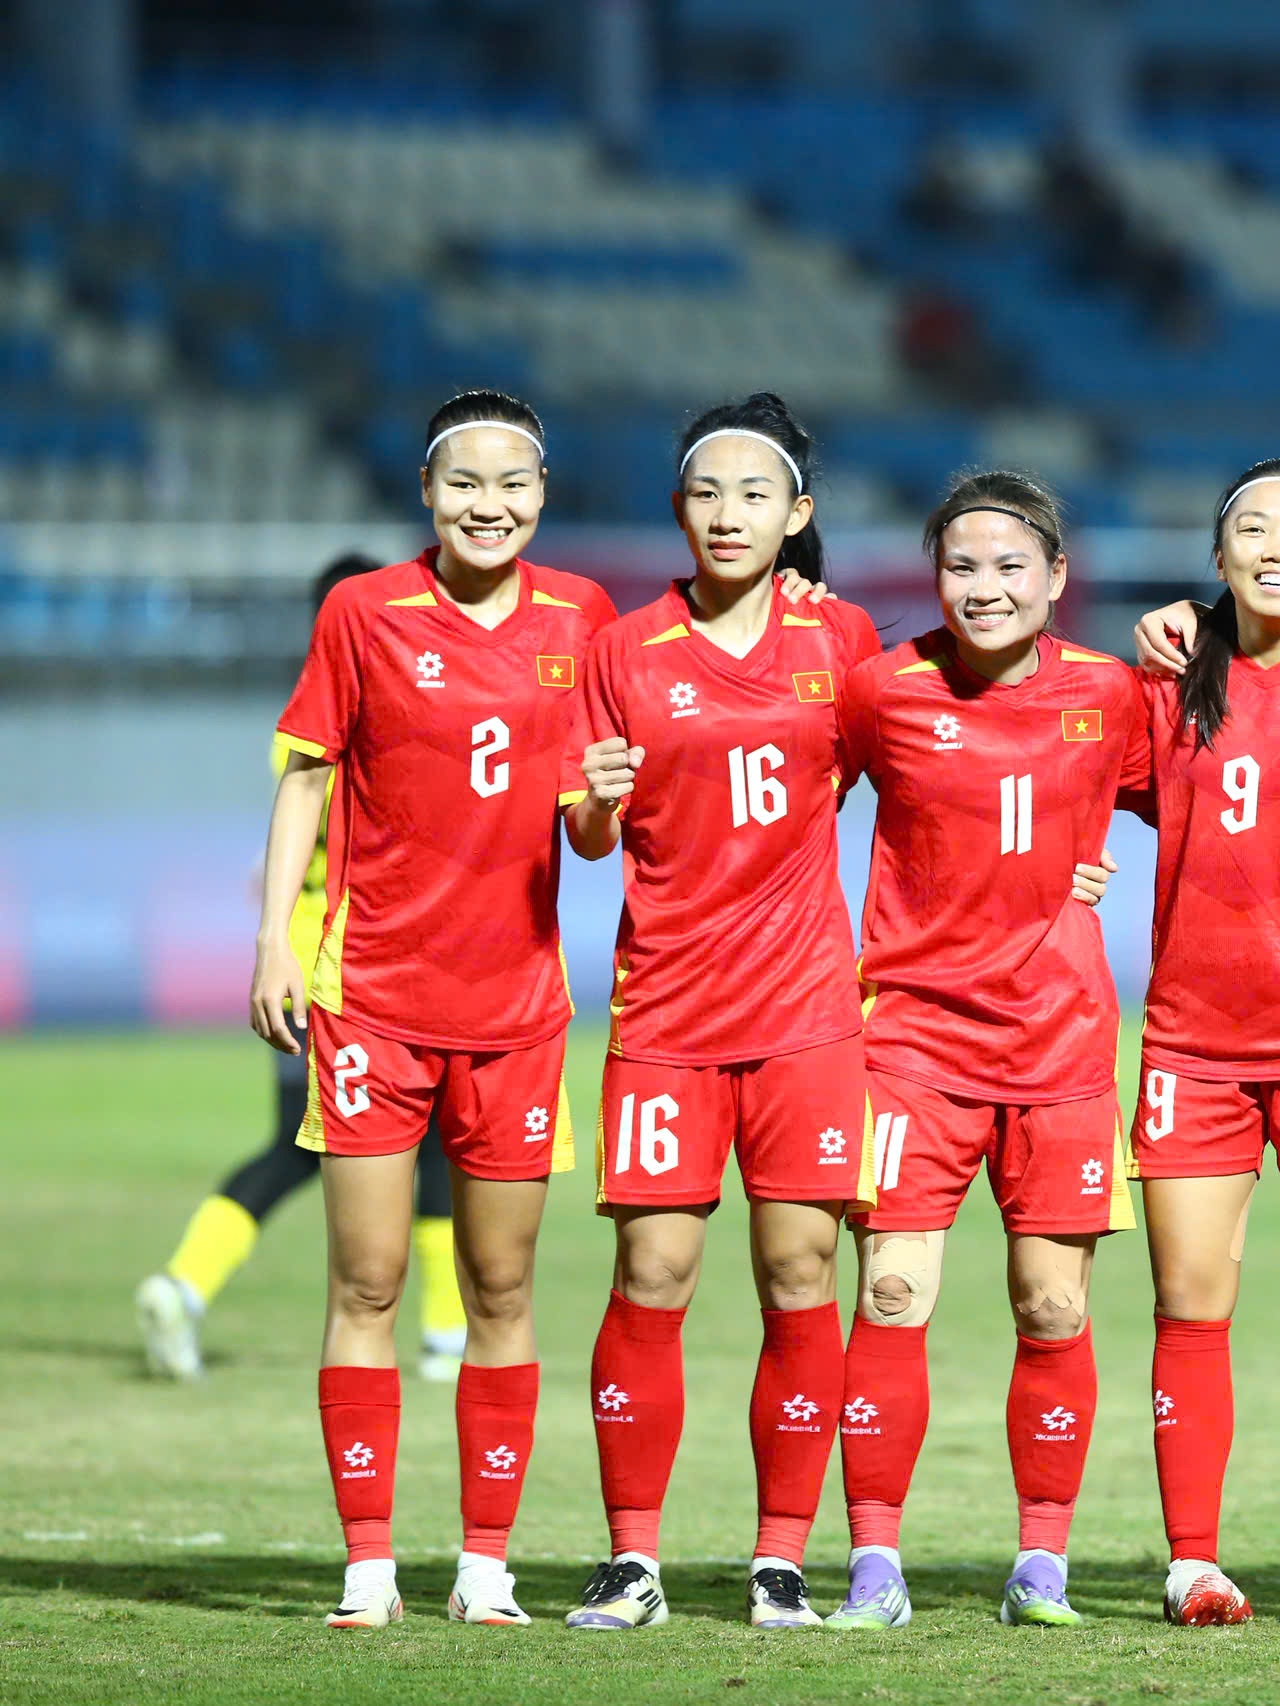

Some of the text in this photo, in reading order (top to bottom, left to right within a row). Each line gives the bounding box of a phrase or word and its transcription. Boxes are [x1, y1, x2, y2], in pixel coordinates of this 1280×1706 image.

[471, 716, 510, 799] 2
[728, 743, 788, 829] 16
[1220, 754, 1261, 835] 9
[999, 774, 1033, 856] 11
[333, 1043, 371, 1119] 2
[1145, 1069, 1178, 1142] 9
[615, 1093, 680, 1177] 16
[874, 1111, 910, 1193] 11
